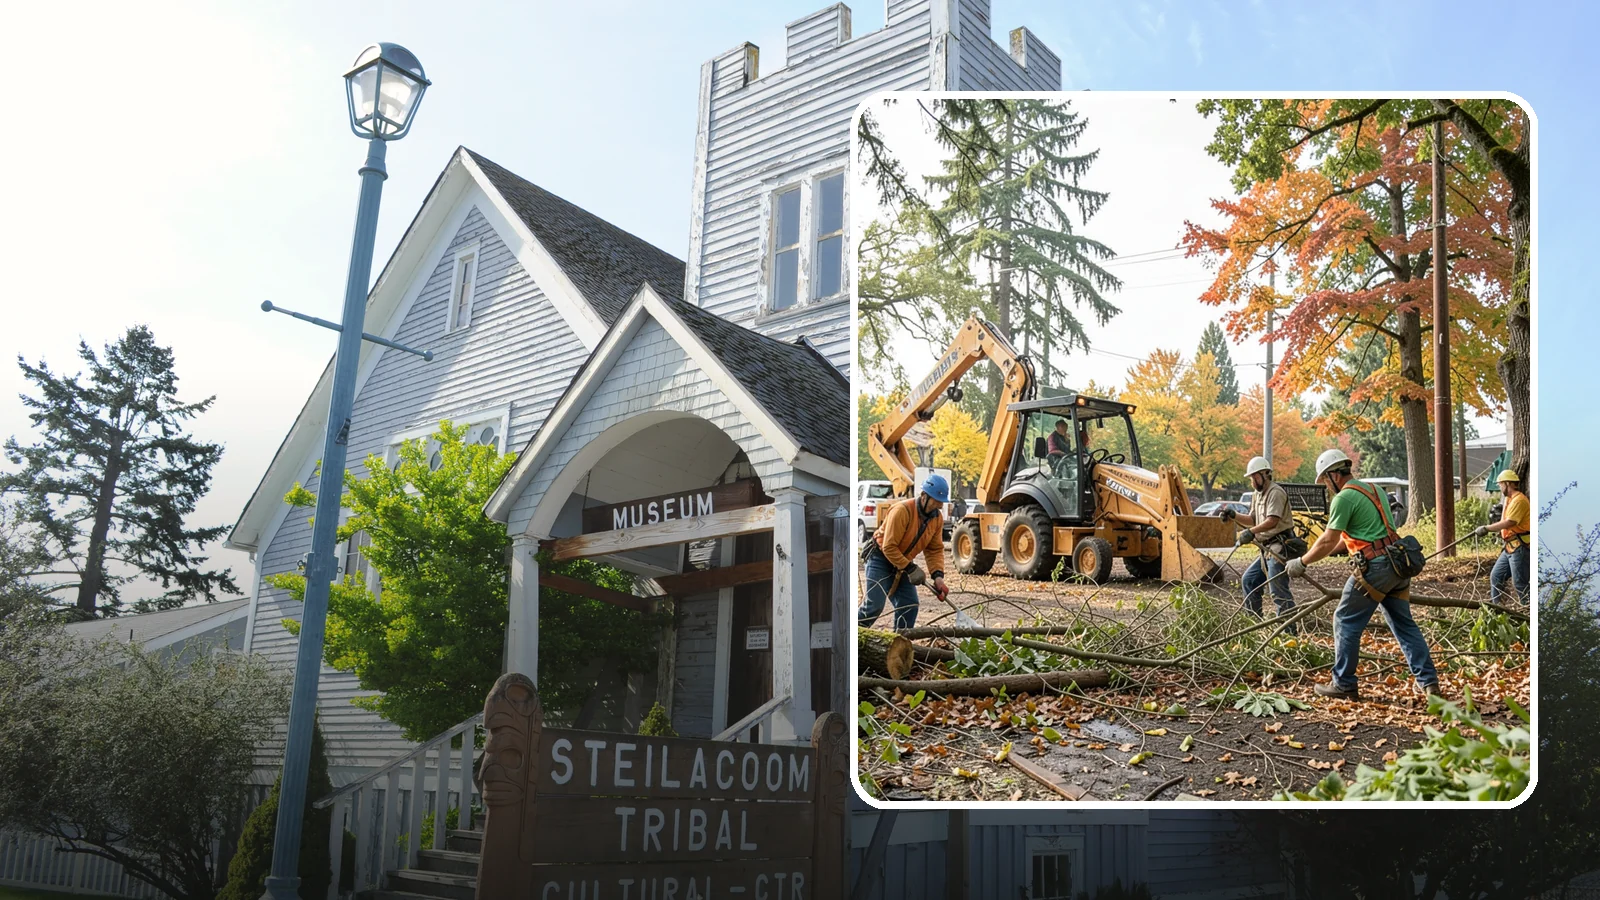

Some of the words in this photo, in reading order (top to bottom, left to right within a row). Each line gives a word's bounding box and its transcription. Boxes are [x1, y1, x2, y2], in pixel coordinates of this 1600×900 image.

[613, 491, 714, 531] MUSEUM
[550, 738, 810, 792] STEILACOOM
[615, 806, 758, 851] TRIBAL
